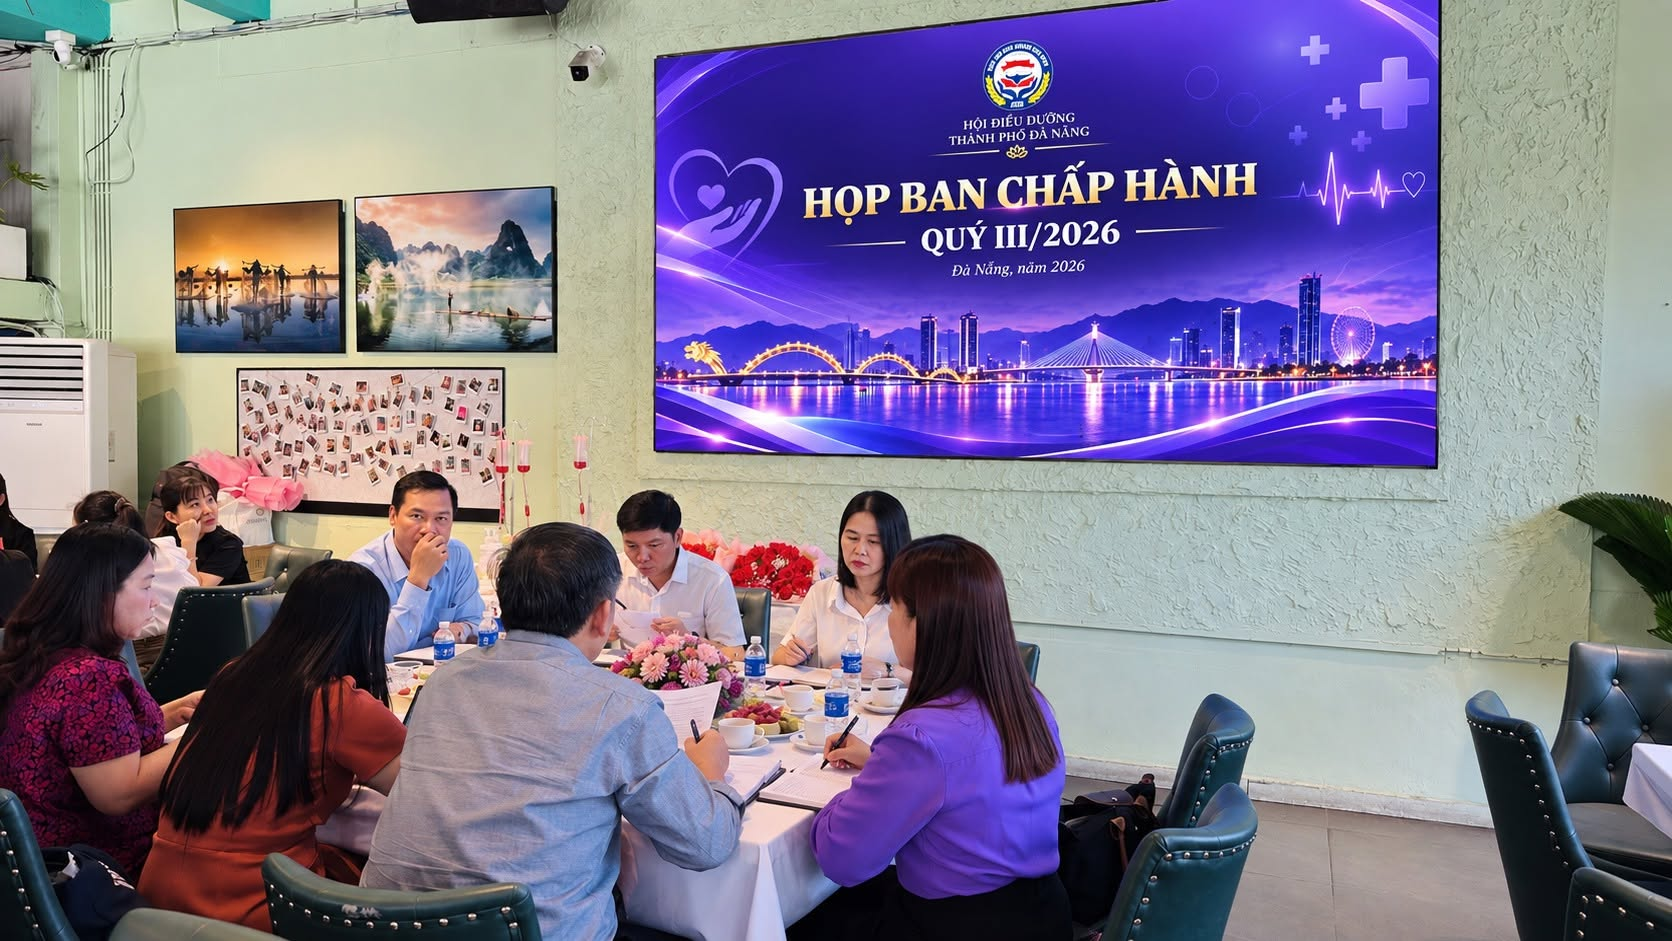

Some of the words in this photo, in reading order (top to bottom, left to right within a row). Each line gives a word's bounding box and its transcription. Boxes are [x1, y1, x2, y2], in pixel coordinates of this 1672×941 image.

[803, 184, 891, 226] HỌP
[900, 177, 988, 214] BAN
[997, 160, 1115, 209] CHẤP
[1124, 158, 1258, 202] HÀNH
[921, 219, 988, 257] QUÝ
[994, 219, 1121, 252] III/2026
[951, 264, 971, 277] Đà
[1050, 259, 1086, 273] 2026
